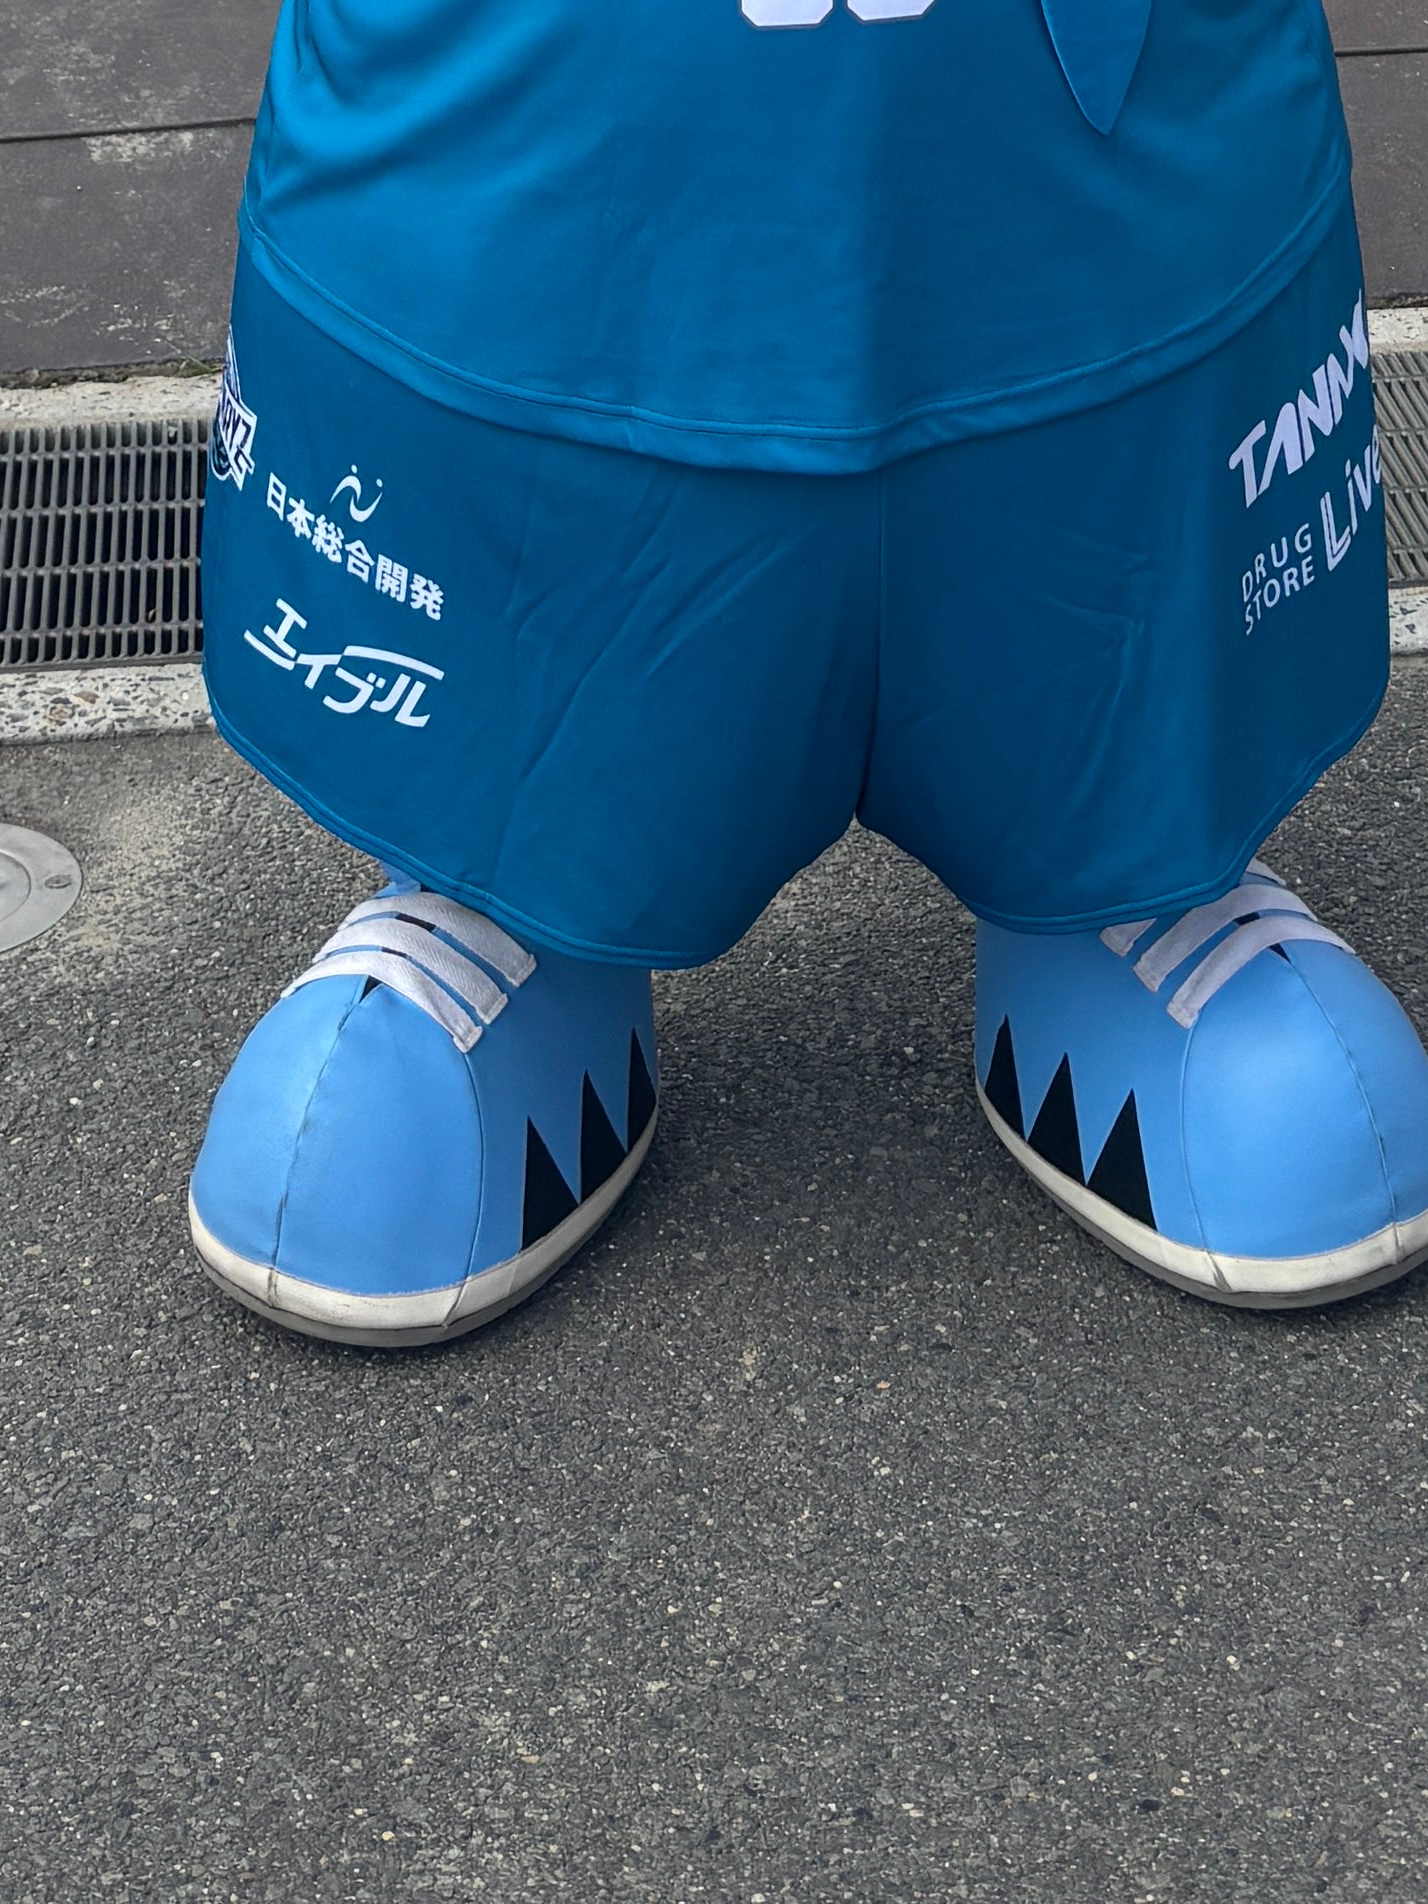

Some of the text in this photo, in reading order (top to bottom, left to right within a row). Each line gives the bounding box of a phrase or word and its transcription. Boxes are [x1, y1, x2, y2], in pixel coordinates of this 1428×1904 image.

[266, 472, 445, 621] 日本総合開発
[1242, 522, 1313, 603] DRUG
[1245, 555, 1316, 636] STORE
[243, 598, 446, 728] エイブル
